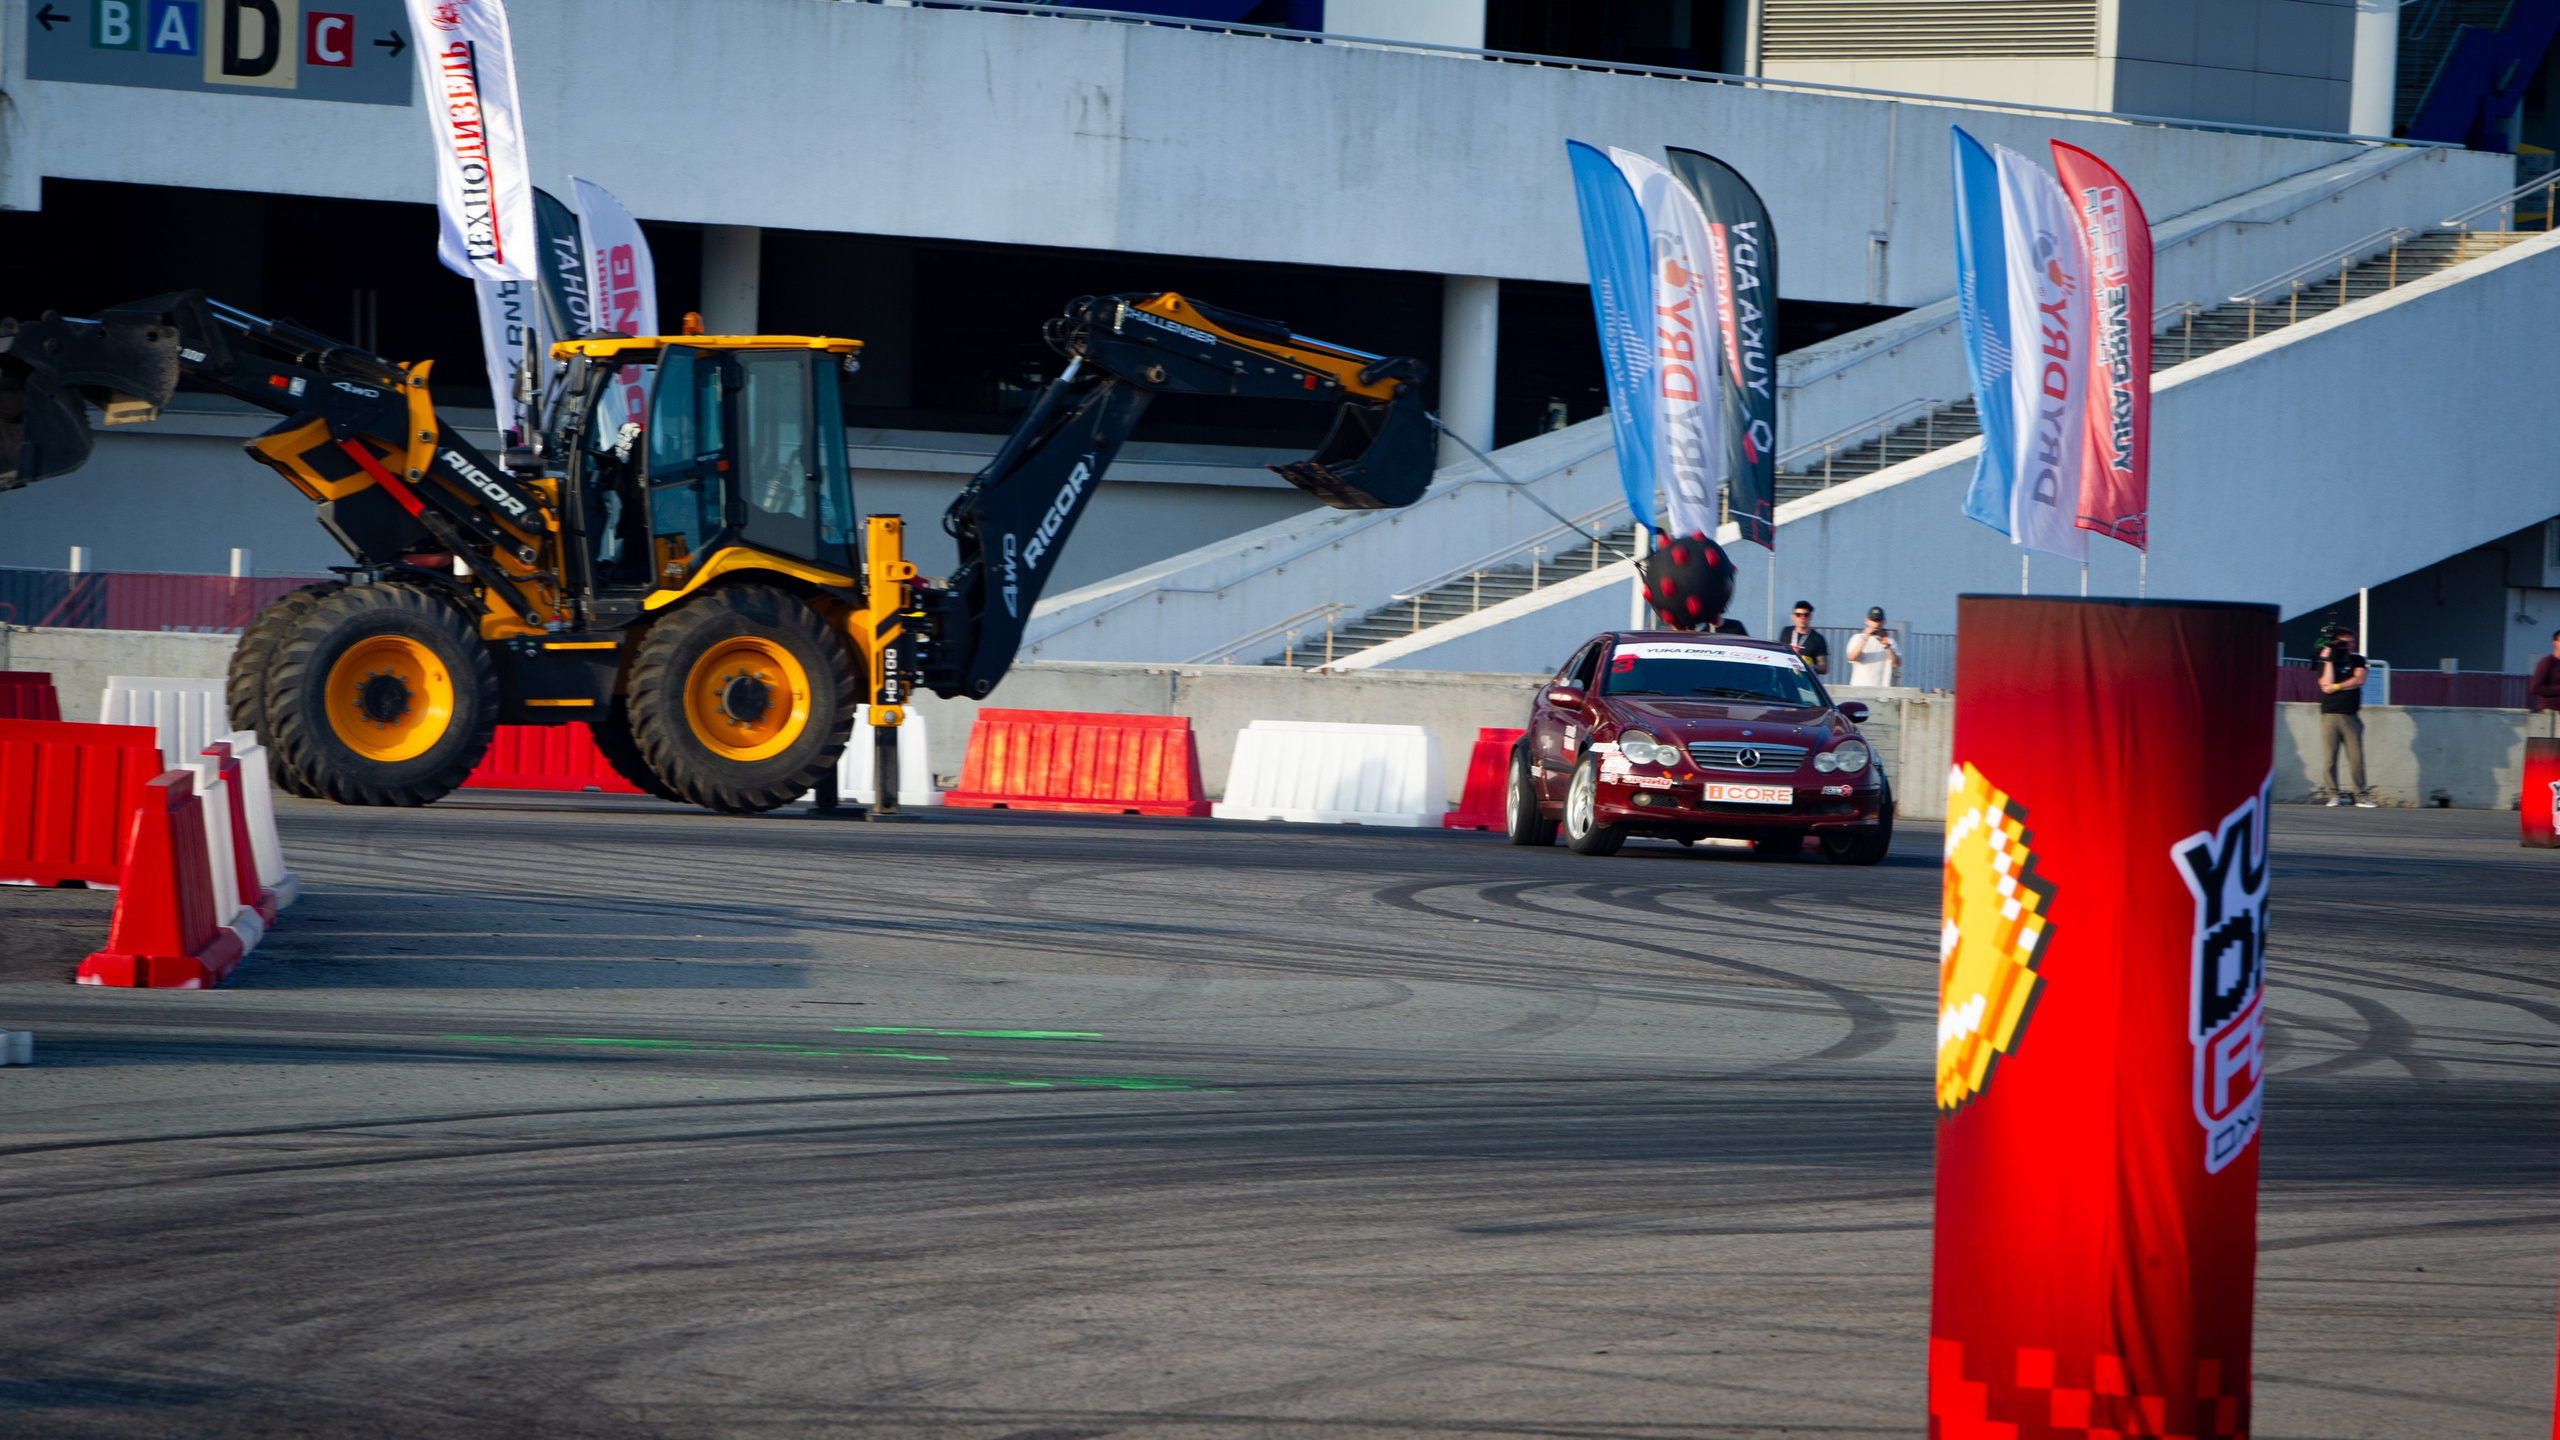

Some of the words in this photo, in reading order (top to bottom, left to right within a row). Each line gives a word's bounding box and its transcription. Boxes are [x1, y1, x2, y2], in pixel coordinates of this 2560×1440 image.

[101, 0, 131, 45] B
[153, 5, 191, 51] A
[221, 0, 281, 77] D
[315, 17, 346, 62] C
[440, 41, 496, 264] ТЕХНОДИЗЕЛЬ
[332, 381, 380, 399] 4WD
[440, 450, 527, 517] RIGOR
[1022, 461, 1092, 570] RIGOR
[1002, 533, 1019, 619] 4WD
[1611, 658, 1634, 673] 3
